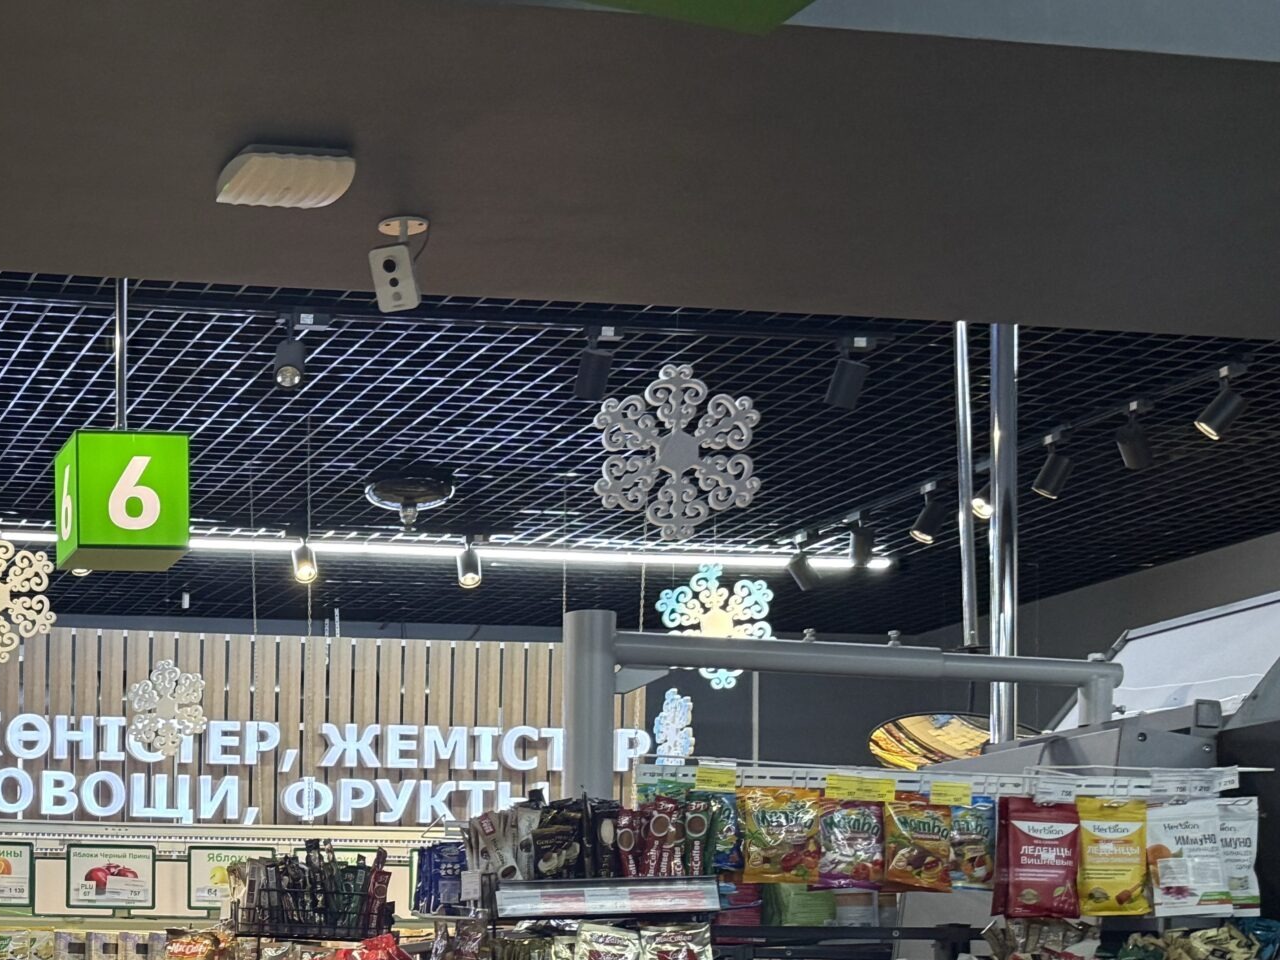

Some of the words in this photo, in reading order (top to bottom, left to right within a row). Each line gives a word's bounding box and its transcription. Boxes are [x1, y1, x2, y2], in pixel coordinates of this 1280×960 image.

[61, 464, 72, 541] 6
[108, 455, 161, 530] 6
[320, 723, 652, 772] ЖЕМІСТР
[897, 814, 951, 840] Mamba
[1027, 824, 1064, 836] Herbion
[1093, 823, 1129, 834] Herbion
[1163, 820, 1200, 831] Herbion
